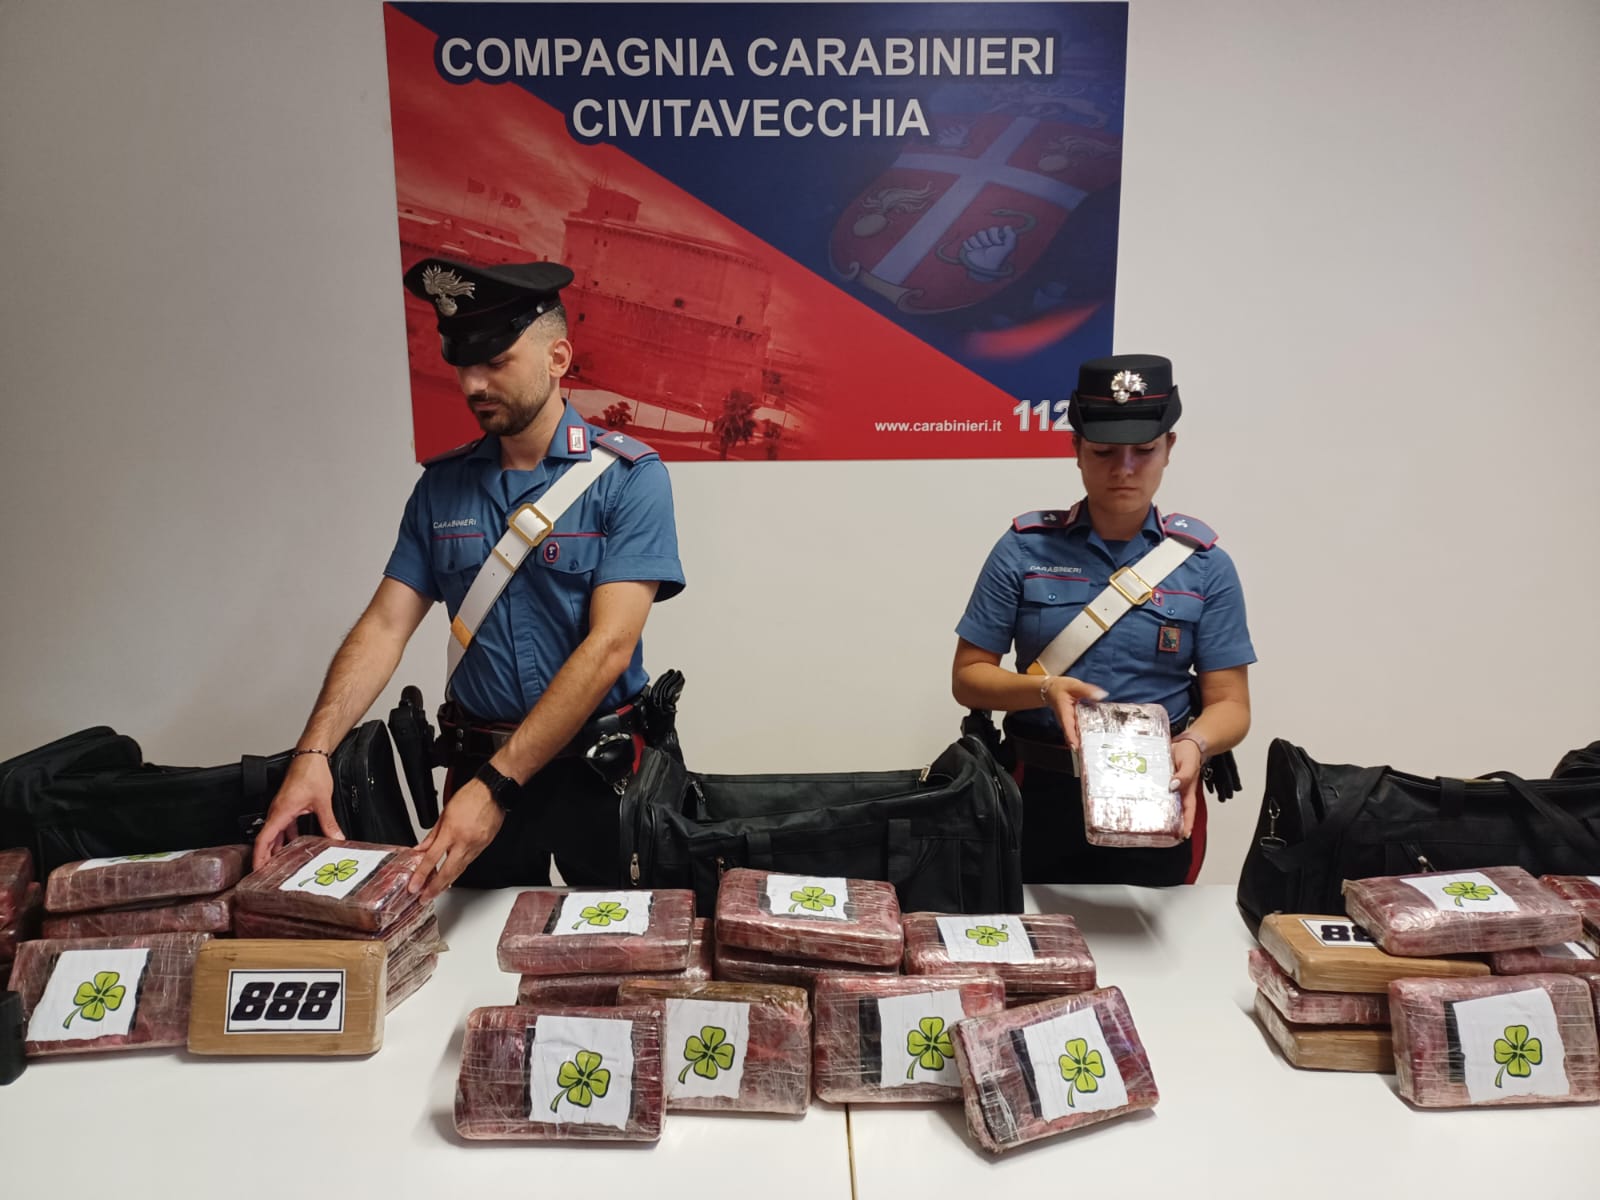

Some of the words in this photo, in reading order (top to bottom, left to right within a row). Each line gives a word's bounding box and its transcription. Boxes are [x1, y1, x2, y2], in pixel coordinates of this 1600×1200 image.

[441, 37, 735, 77] COMPAGNIA
[747, 37, 1055, 77] CARABINIERI
[572, 98, 931, 138] CIVITAVECCHIA
[874, 419, 1003, 432] www.carabinieri.it
[1013, 399, 1075, 432] 112
[432, 518, 477, 529] CARABINIERI
[231, 982, 340, 1021] 888
